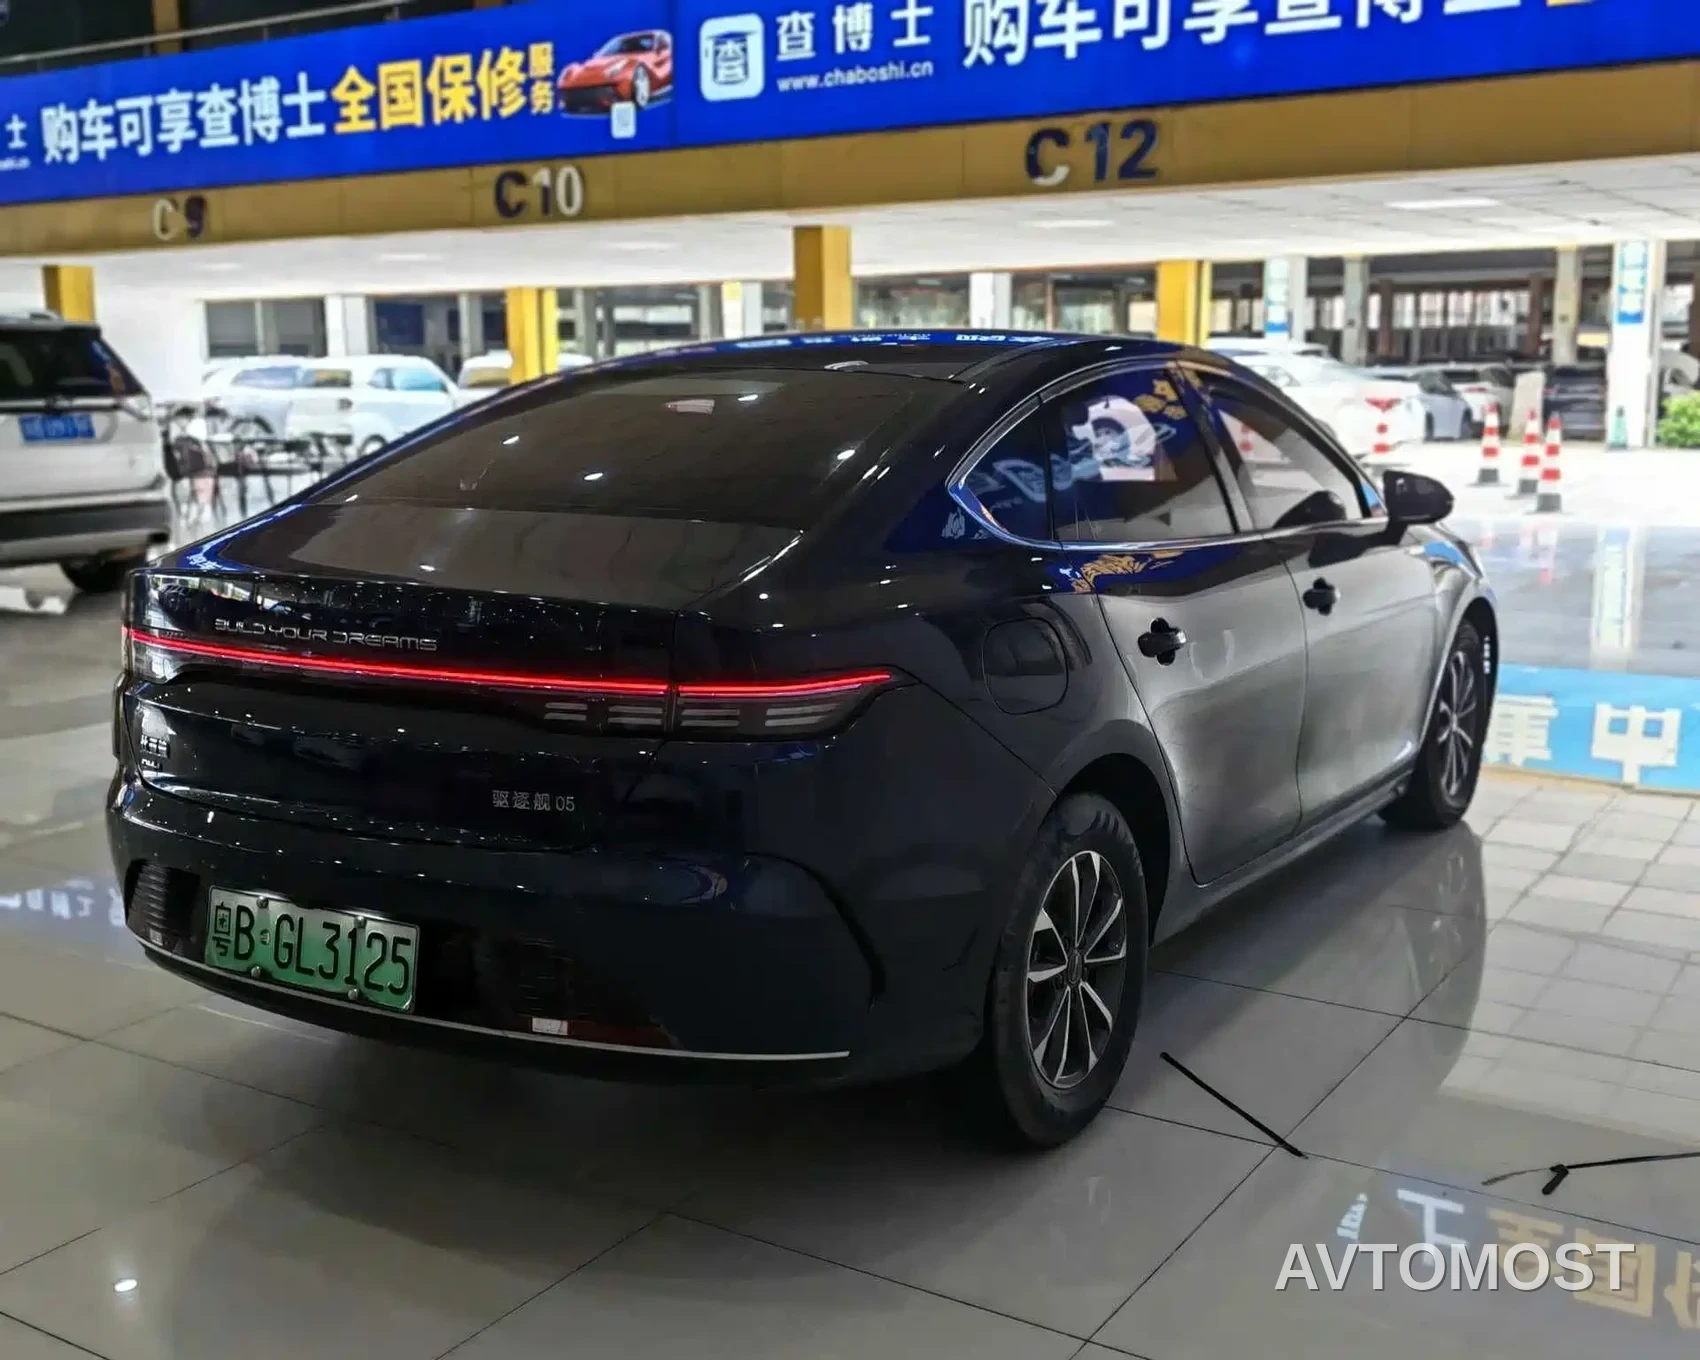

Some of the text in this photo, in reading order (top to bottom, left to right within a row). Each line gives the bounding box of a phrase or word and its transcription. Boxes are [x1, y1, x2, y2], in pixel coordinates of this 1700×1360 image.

[776, 60, 935, 92] www.chaboshi.cn
[494, 165, 585, 218] C10
[214, 618, 438, 652] BUILD YOUR DREAMS
